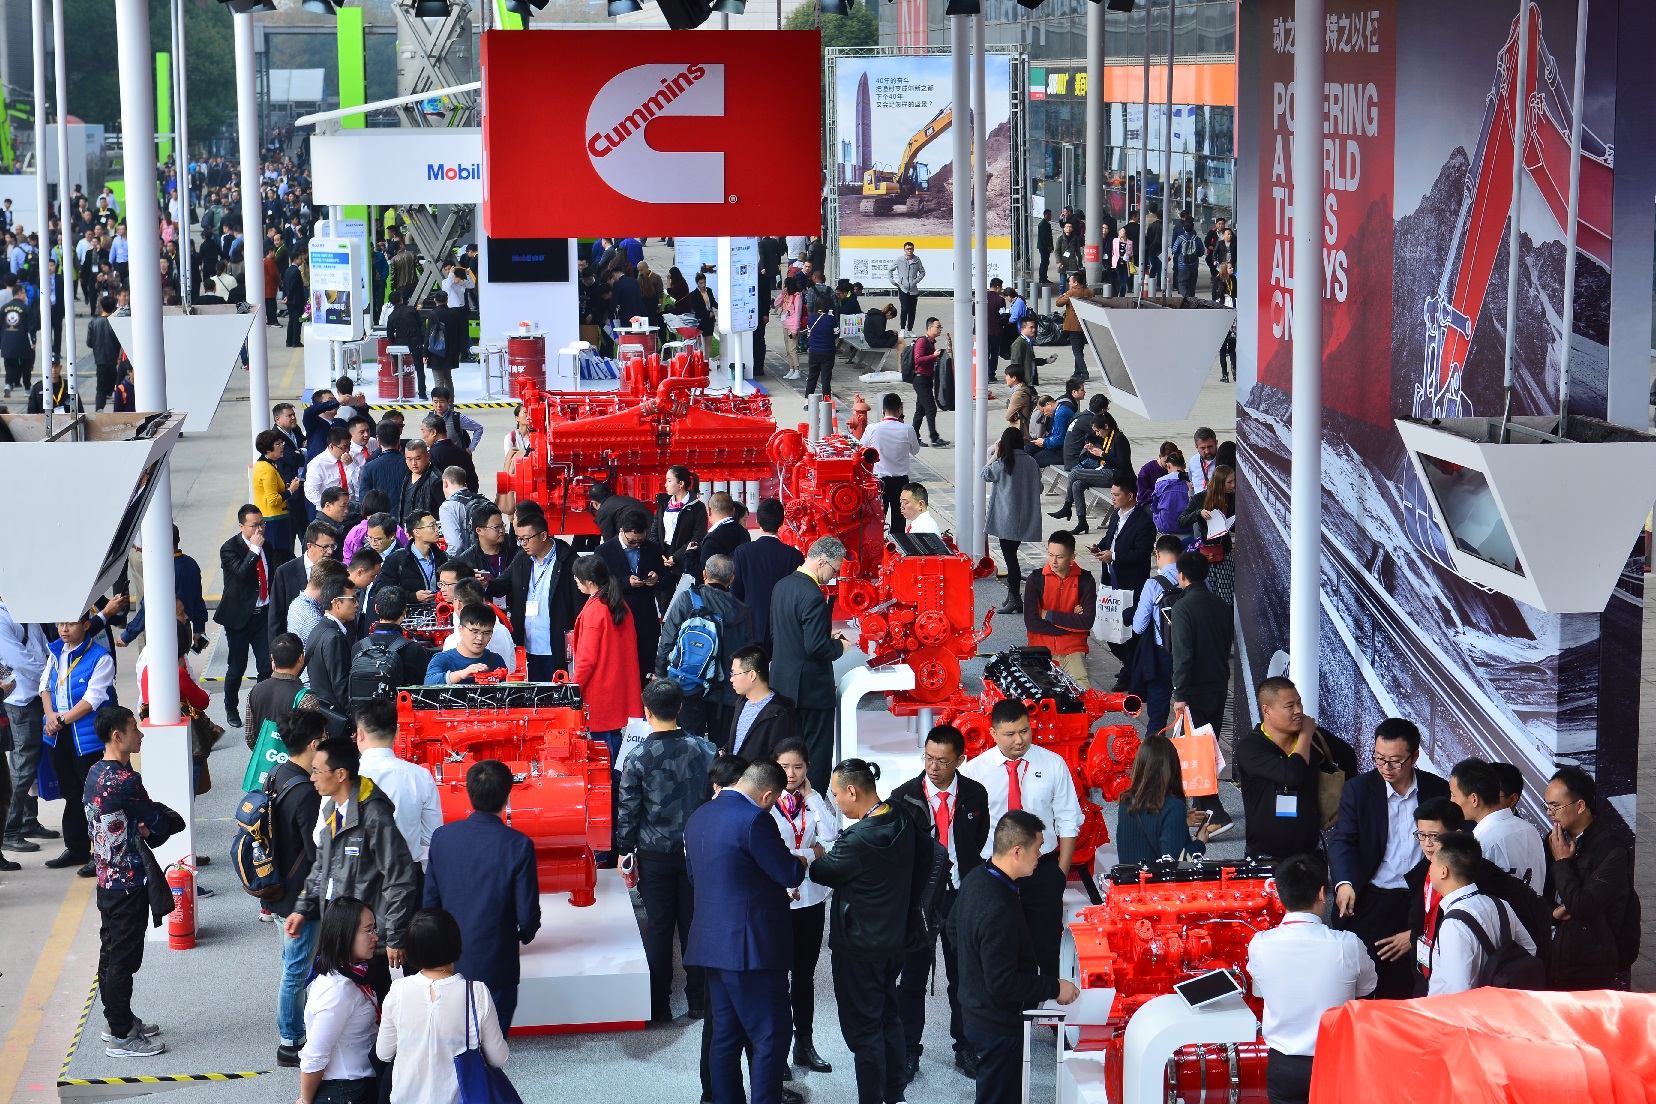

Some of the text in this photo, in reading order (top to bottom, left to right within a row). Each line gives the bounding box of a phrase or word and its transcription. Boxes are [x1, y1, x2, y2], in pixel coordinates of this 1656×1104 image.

[588, 64, 705, 157] Cummins
[1273, 81, 1378, 137] POERING
[427, 163, 480, 180] Mobil
[1272, 134, 1285, 183] A
[1271, 239, 1348, 303] ALYS
